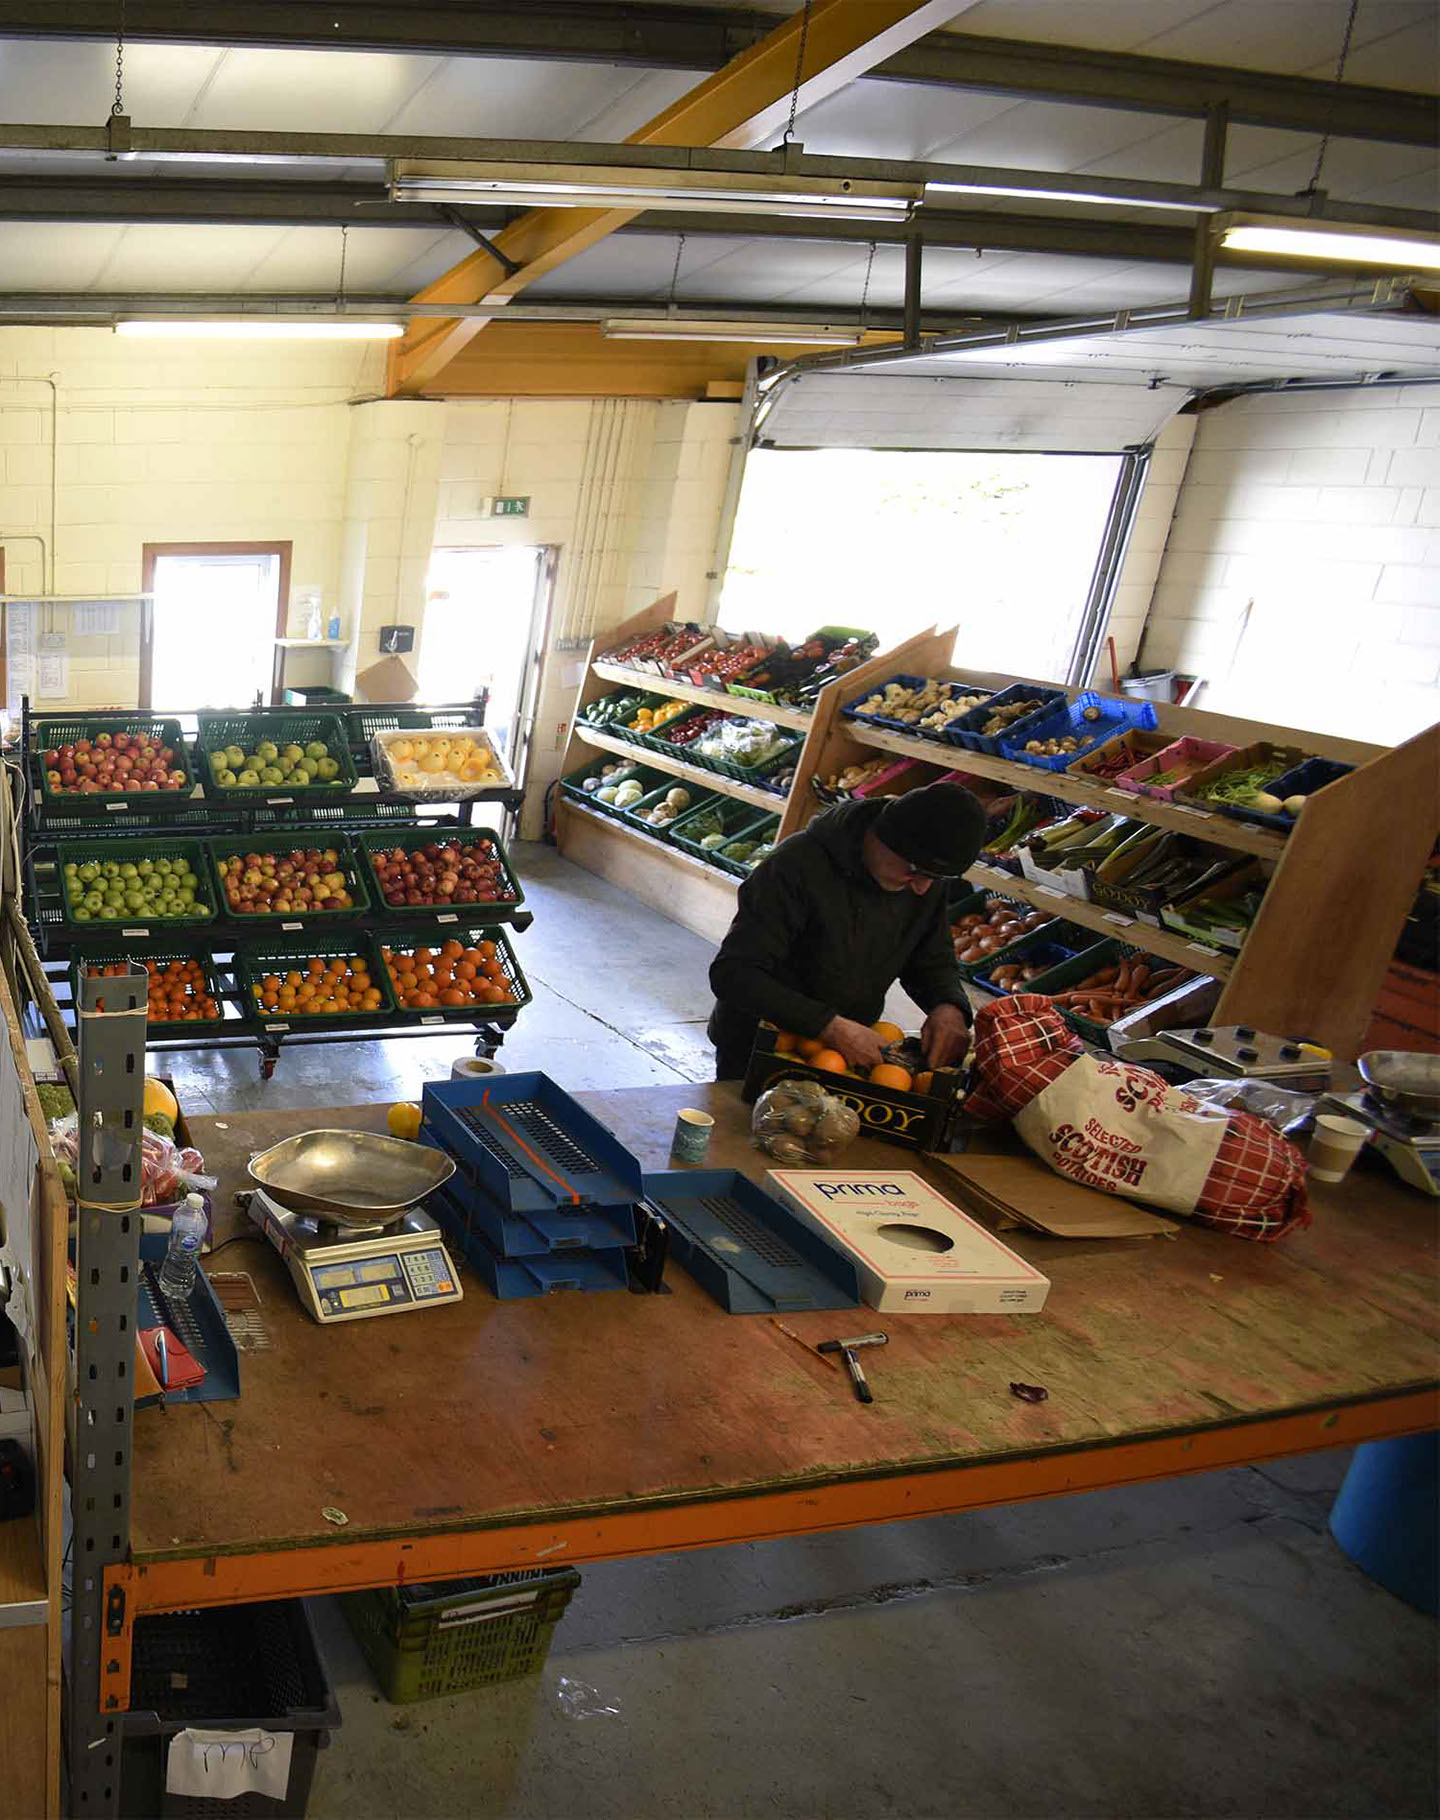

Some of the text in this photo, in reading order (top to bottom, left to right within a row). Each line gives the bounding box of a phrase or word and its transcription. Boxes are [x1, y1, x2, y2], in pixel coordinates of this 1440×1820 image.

[1085, 1118, 1142, 1154] SELECTED
[1052, 1152, 1117, 1191] POTATOES
[813, 1182, 906, 1200] prima
[904, 1290, 931, 1301] prima
